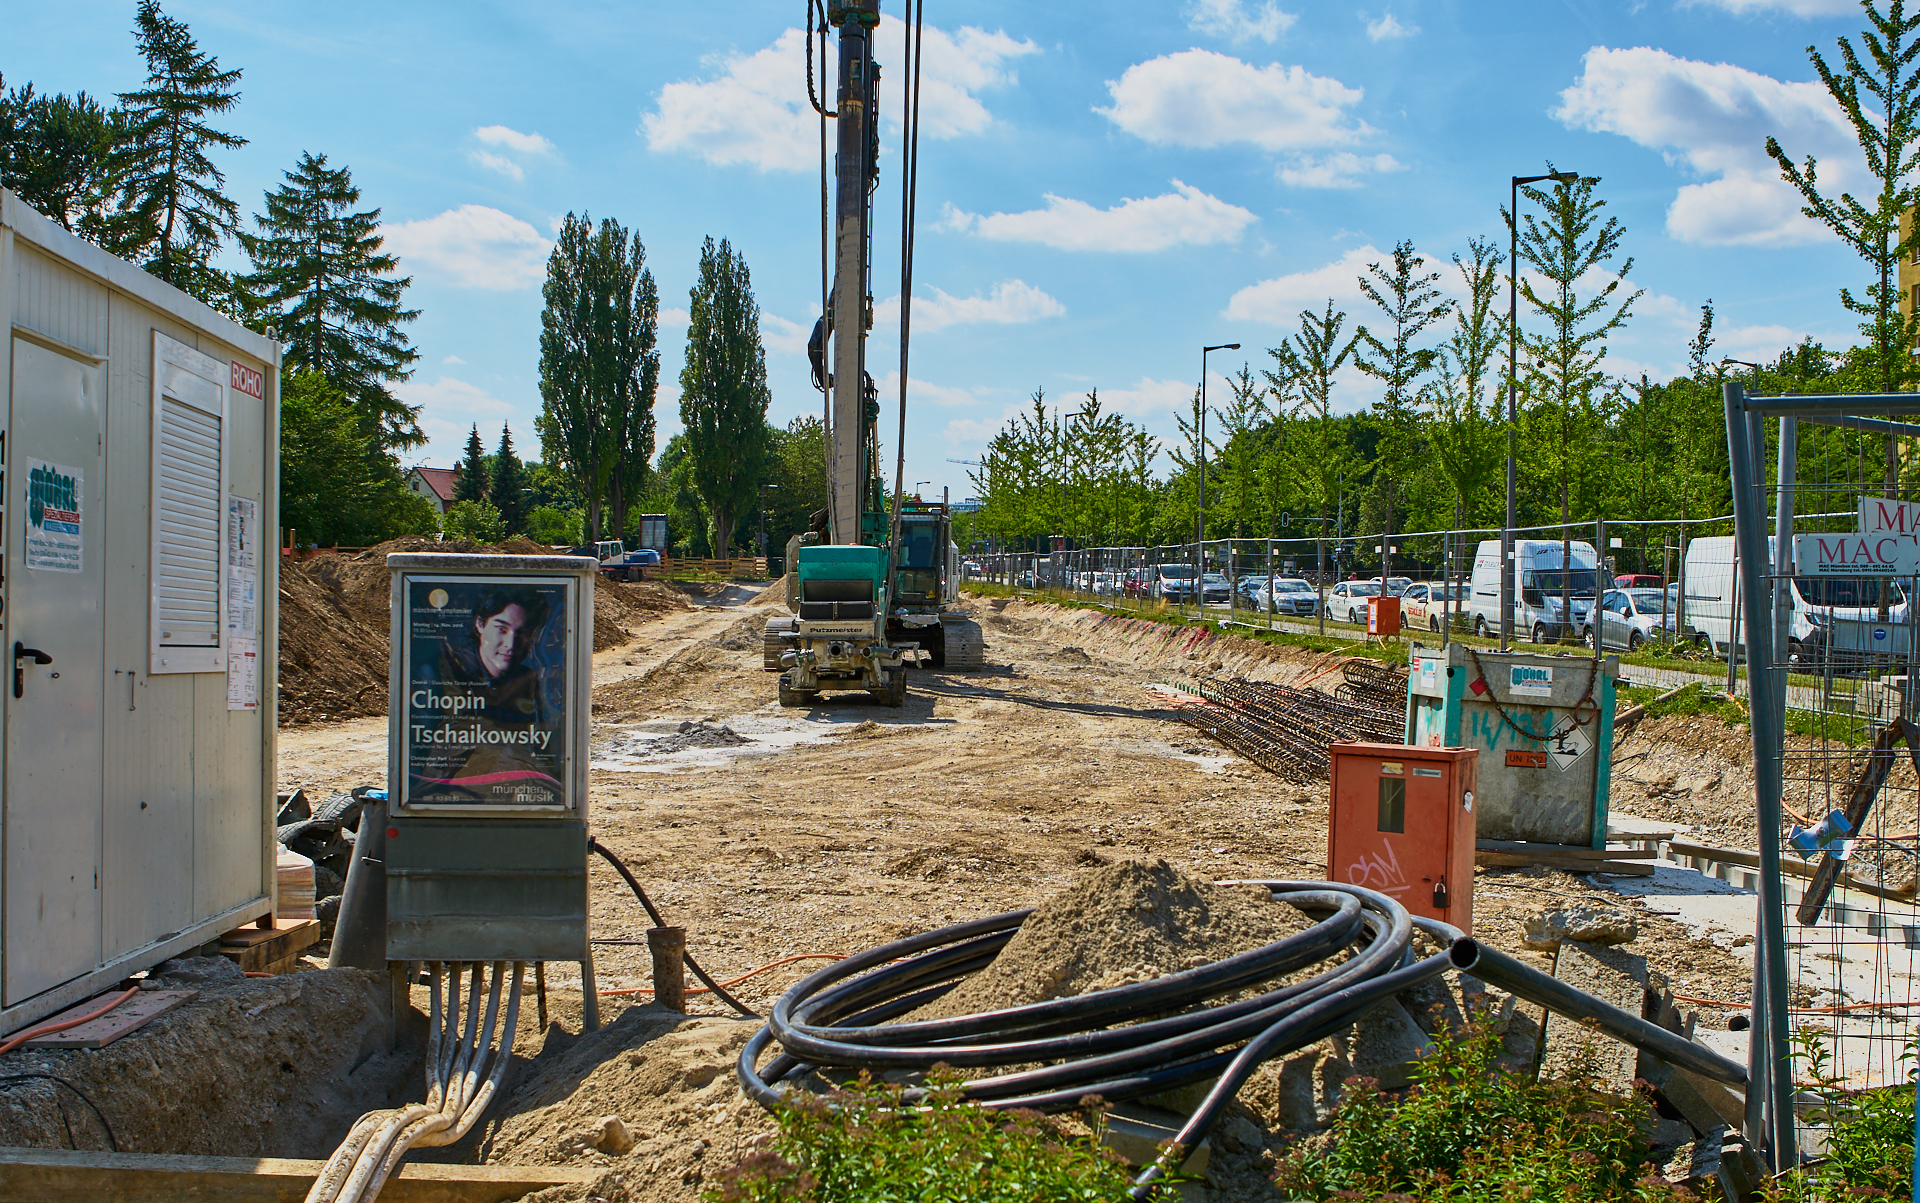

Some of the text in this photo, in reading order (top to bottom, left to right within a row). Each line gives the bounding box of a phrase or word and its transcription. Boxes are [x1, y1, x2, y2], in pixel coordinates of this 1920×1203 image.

[232, 363, 262, 397] ROHO
[1816, 538, 1899, 565] MAC
[411, 688, 486, 715] Chopin
[411, 723, 552, 750] Tschaikowsky
[1509, 754, 1523, 763] UN
[492, 783, 544, 795] münchen
[517, 790, 555, 802] musik
